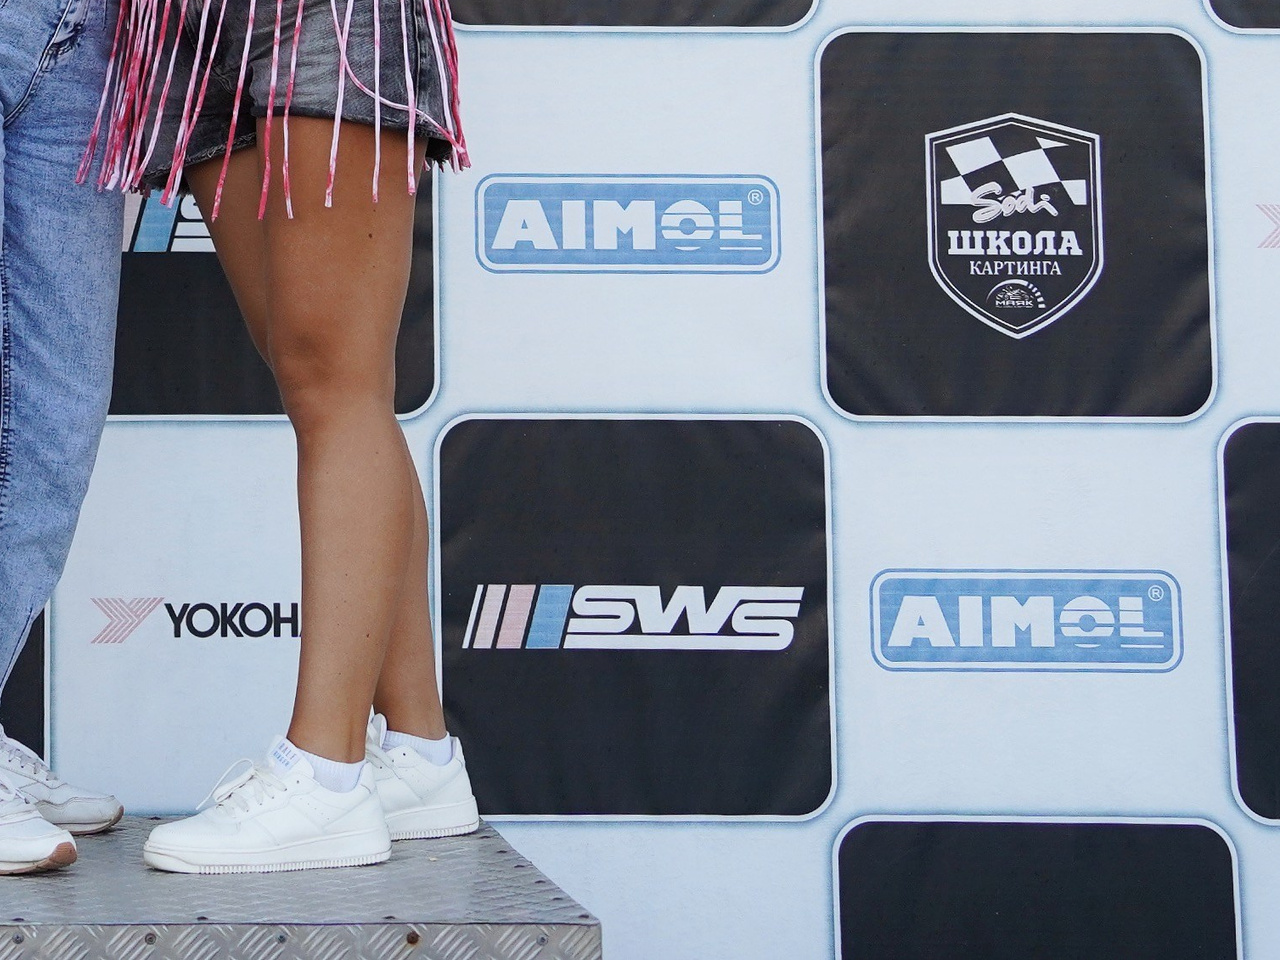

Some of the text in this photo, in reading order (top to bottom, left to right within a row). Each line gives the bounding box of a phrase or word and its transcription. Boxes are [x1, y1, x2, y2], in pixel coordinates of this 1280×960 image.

[971, 181, 1059, 224] Sodi
[947, 230, 1083, 256] ШКОЛА
[969, 260, 1062, 276] КАРТИНГА
[164, 602, 301, 638] YOKOH
[563, 585, 804, 650] SWS
